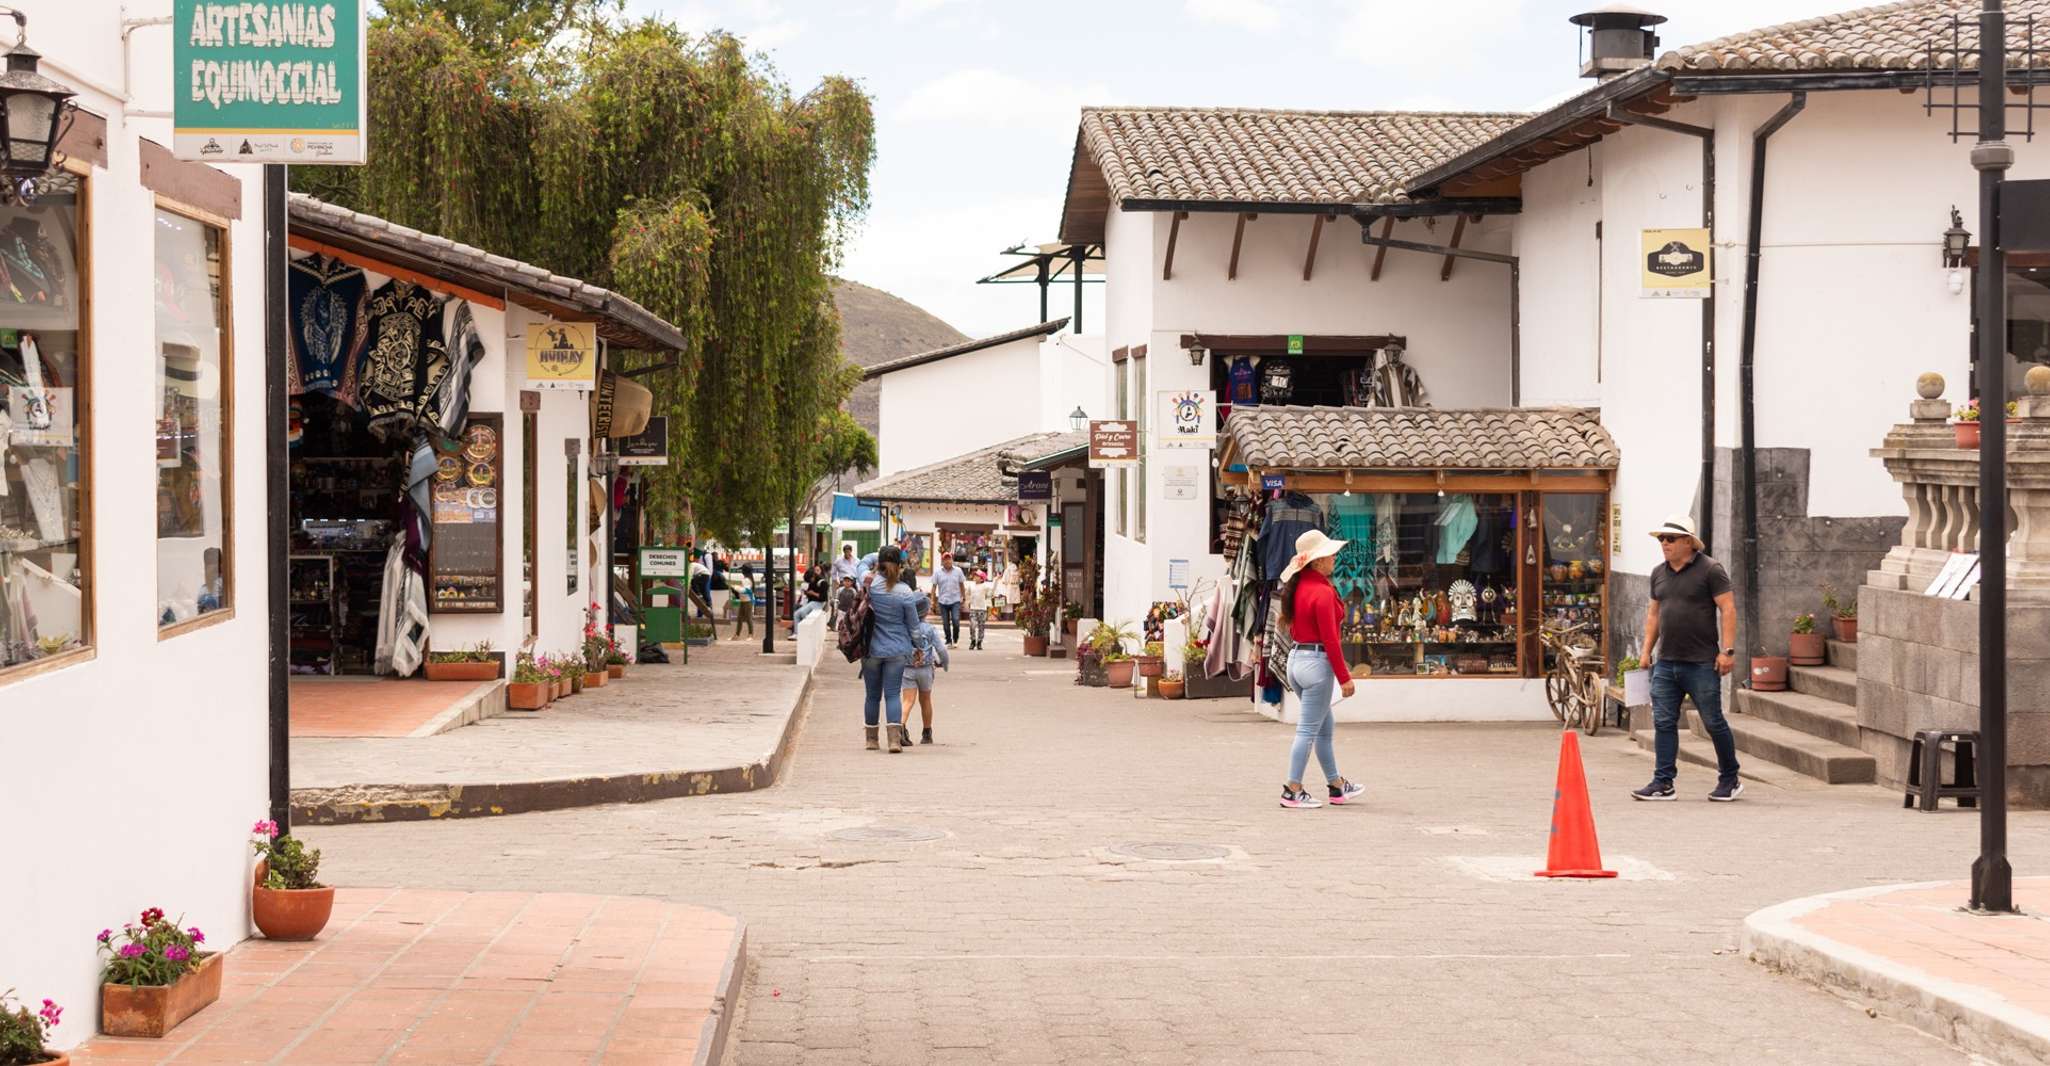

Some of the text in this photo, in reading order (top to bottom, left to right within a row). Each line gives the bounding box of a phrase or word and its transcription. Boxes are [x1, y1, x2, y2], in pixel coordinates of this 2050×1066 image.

[190, 2, 336, 48] ARTESANIAS
[191, 59, 342, 109] EQUINOCCIAL
[1177, 425, 1199, 434] Maki
[1265, 479, 1282, 487] VISA
